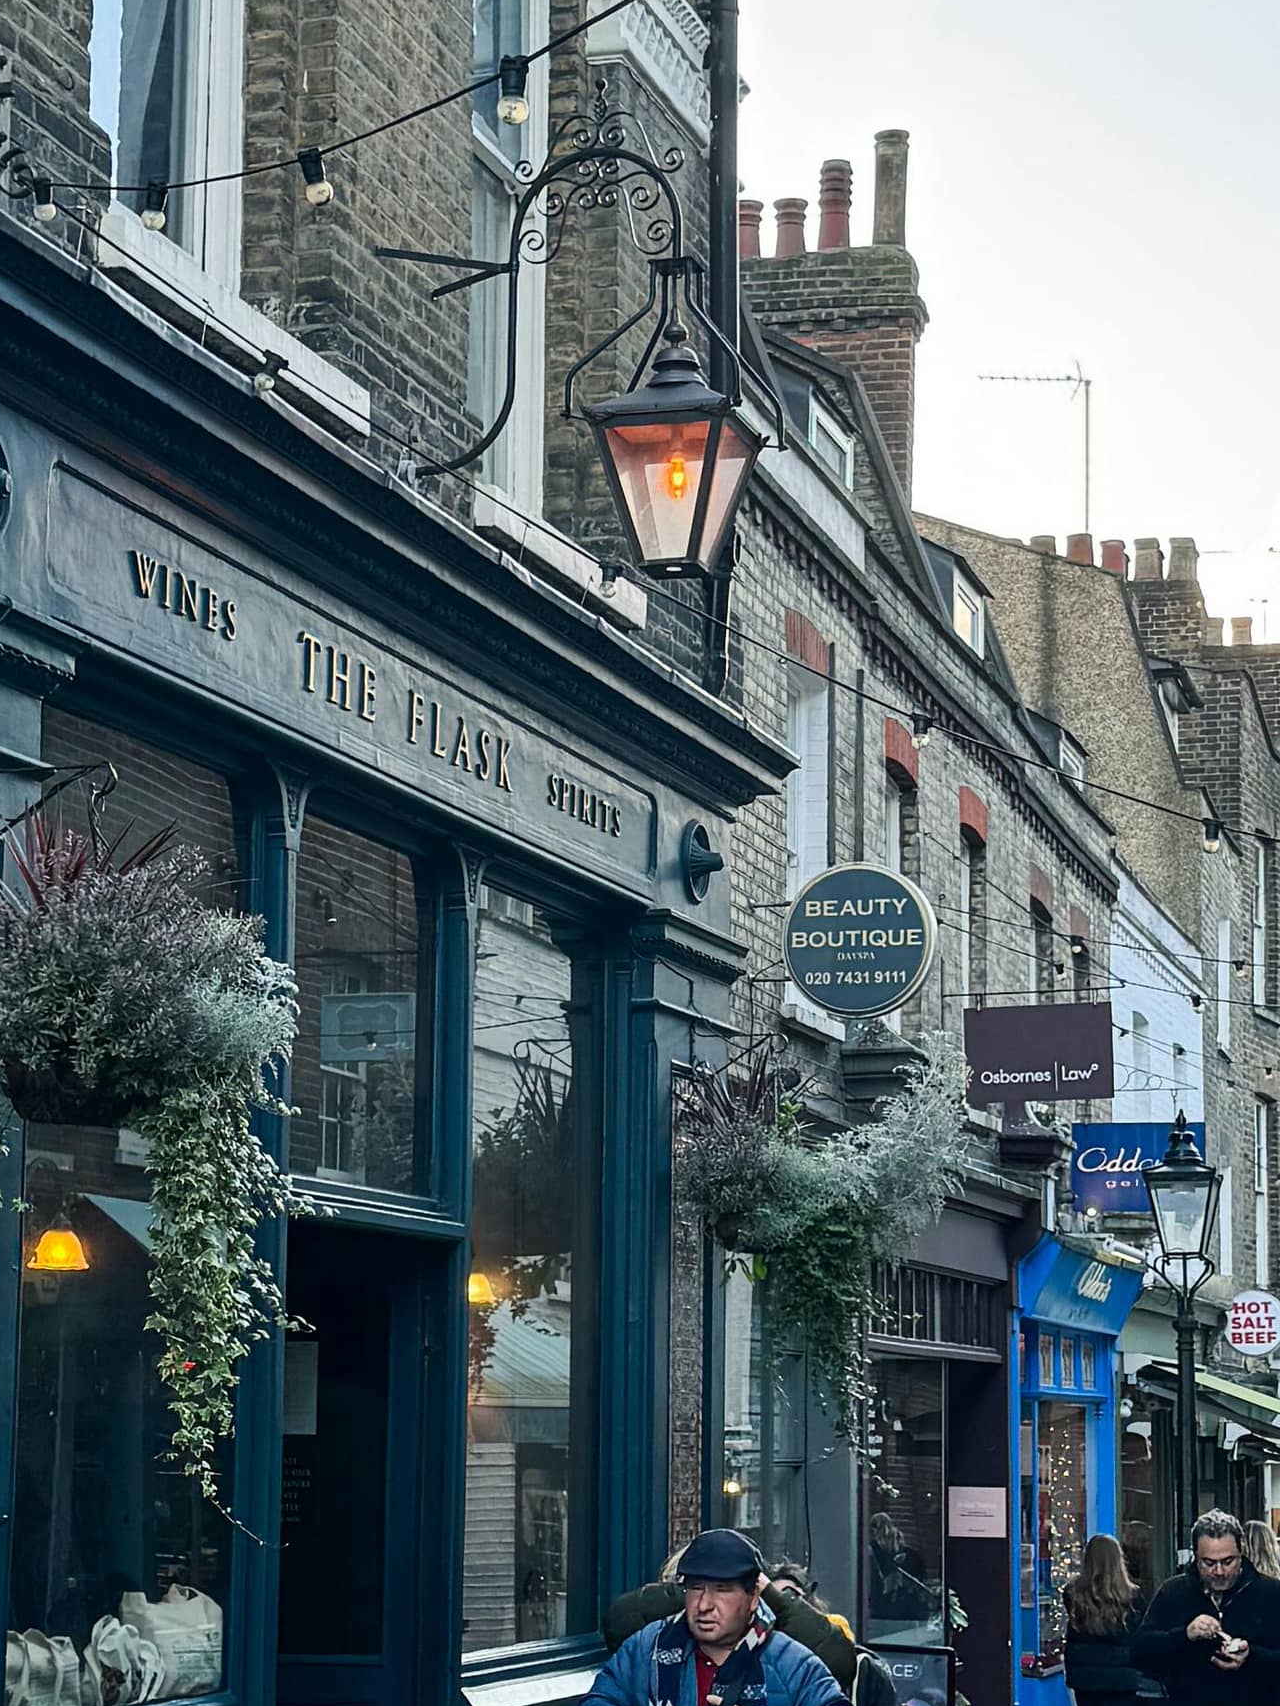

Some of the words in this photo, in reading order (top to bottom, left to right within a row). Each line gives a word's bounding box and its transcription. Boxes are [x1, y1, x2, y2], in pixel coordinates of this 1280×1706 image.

[131, 549, 238, 641] WINES
[300, 630, 377, 723] THE
[409, 690, 513, 793] FLASK
[548, 773, 622, 838] SPIRITS
[805, 898, 908, 917] BEAUTY
[791, 928, 923, 948] BOUTIQUE
[805, 972, 831, 985] 020
[836, 972, 870, 984] 7431
[874, 970, 906, 983] 9111
[980, 1068, 1052, 1085] Osbornes
[1232, 1301, 1272, 1314] HOT
[1231, 1316, 1276, 1329] SALT
[1231, 1332, 1277, 1344] BEEF
